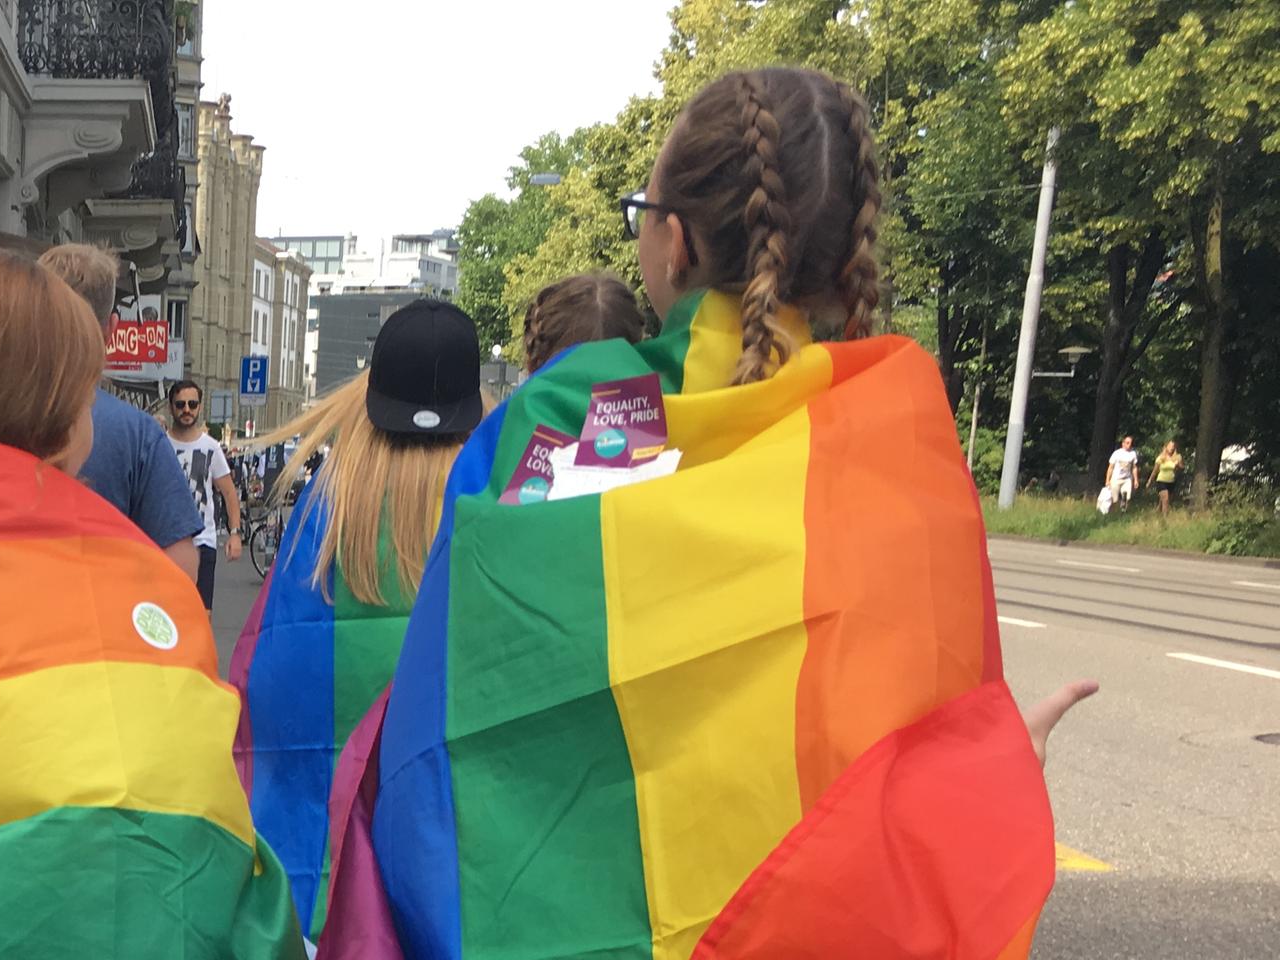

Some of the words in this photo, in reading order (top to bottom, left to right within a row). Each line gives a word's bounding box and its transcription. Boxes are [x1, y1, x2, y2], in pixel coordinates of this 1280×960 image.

[249, 360, 260, 379] P
[596, 396, 650, 414] EQUALITY,
[593, 413, 627, 426] LOVE,
[630, 407, 660, 425] PRIDE
